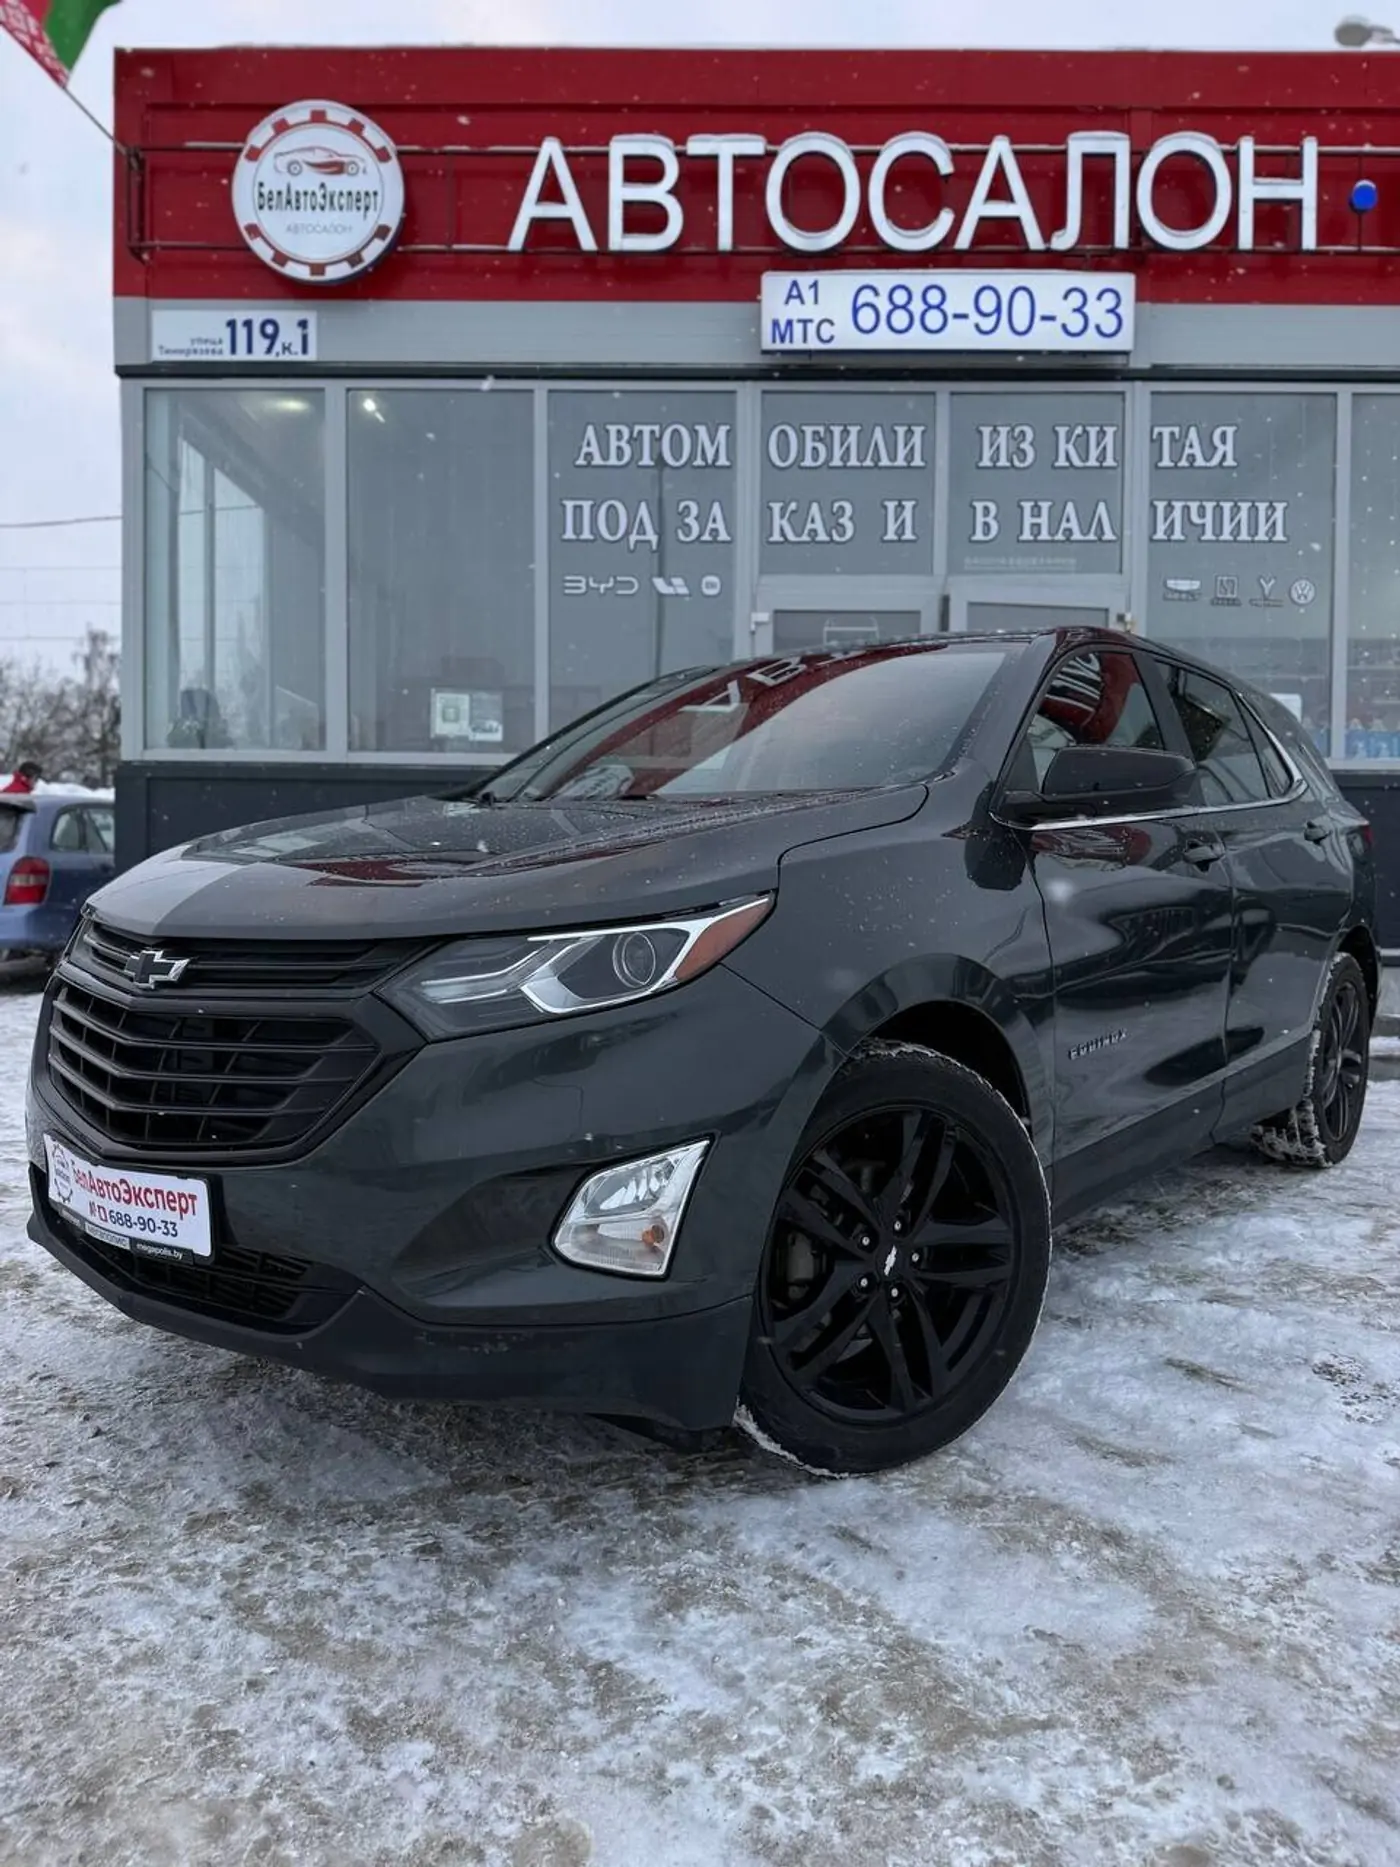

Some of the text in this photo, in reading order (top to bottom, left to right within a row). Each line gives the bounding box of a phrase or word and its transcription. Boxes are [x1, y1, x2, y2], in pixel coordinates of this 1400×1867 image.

[257, 181, 379, 220] БелАвтоЭксперт
[507, 131, 1320, 252] АВТОСАЛОН
[771, 318, 835, 344] МТС
[852, 284, 1124, 338] 688-90-33
[575, 424, 1239, 468] АВТОМ ОБИЛИ ИЗ КИ ТАЯ
[561, 500, 1289, 551] ПОД ЗА КАЗ И В НАЛ ИЧИИ
[109, 1209, 178, 1237] 688-90-33
